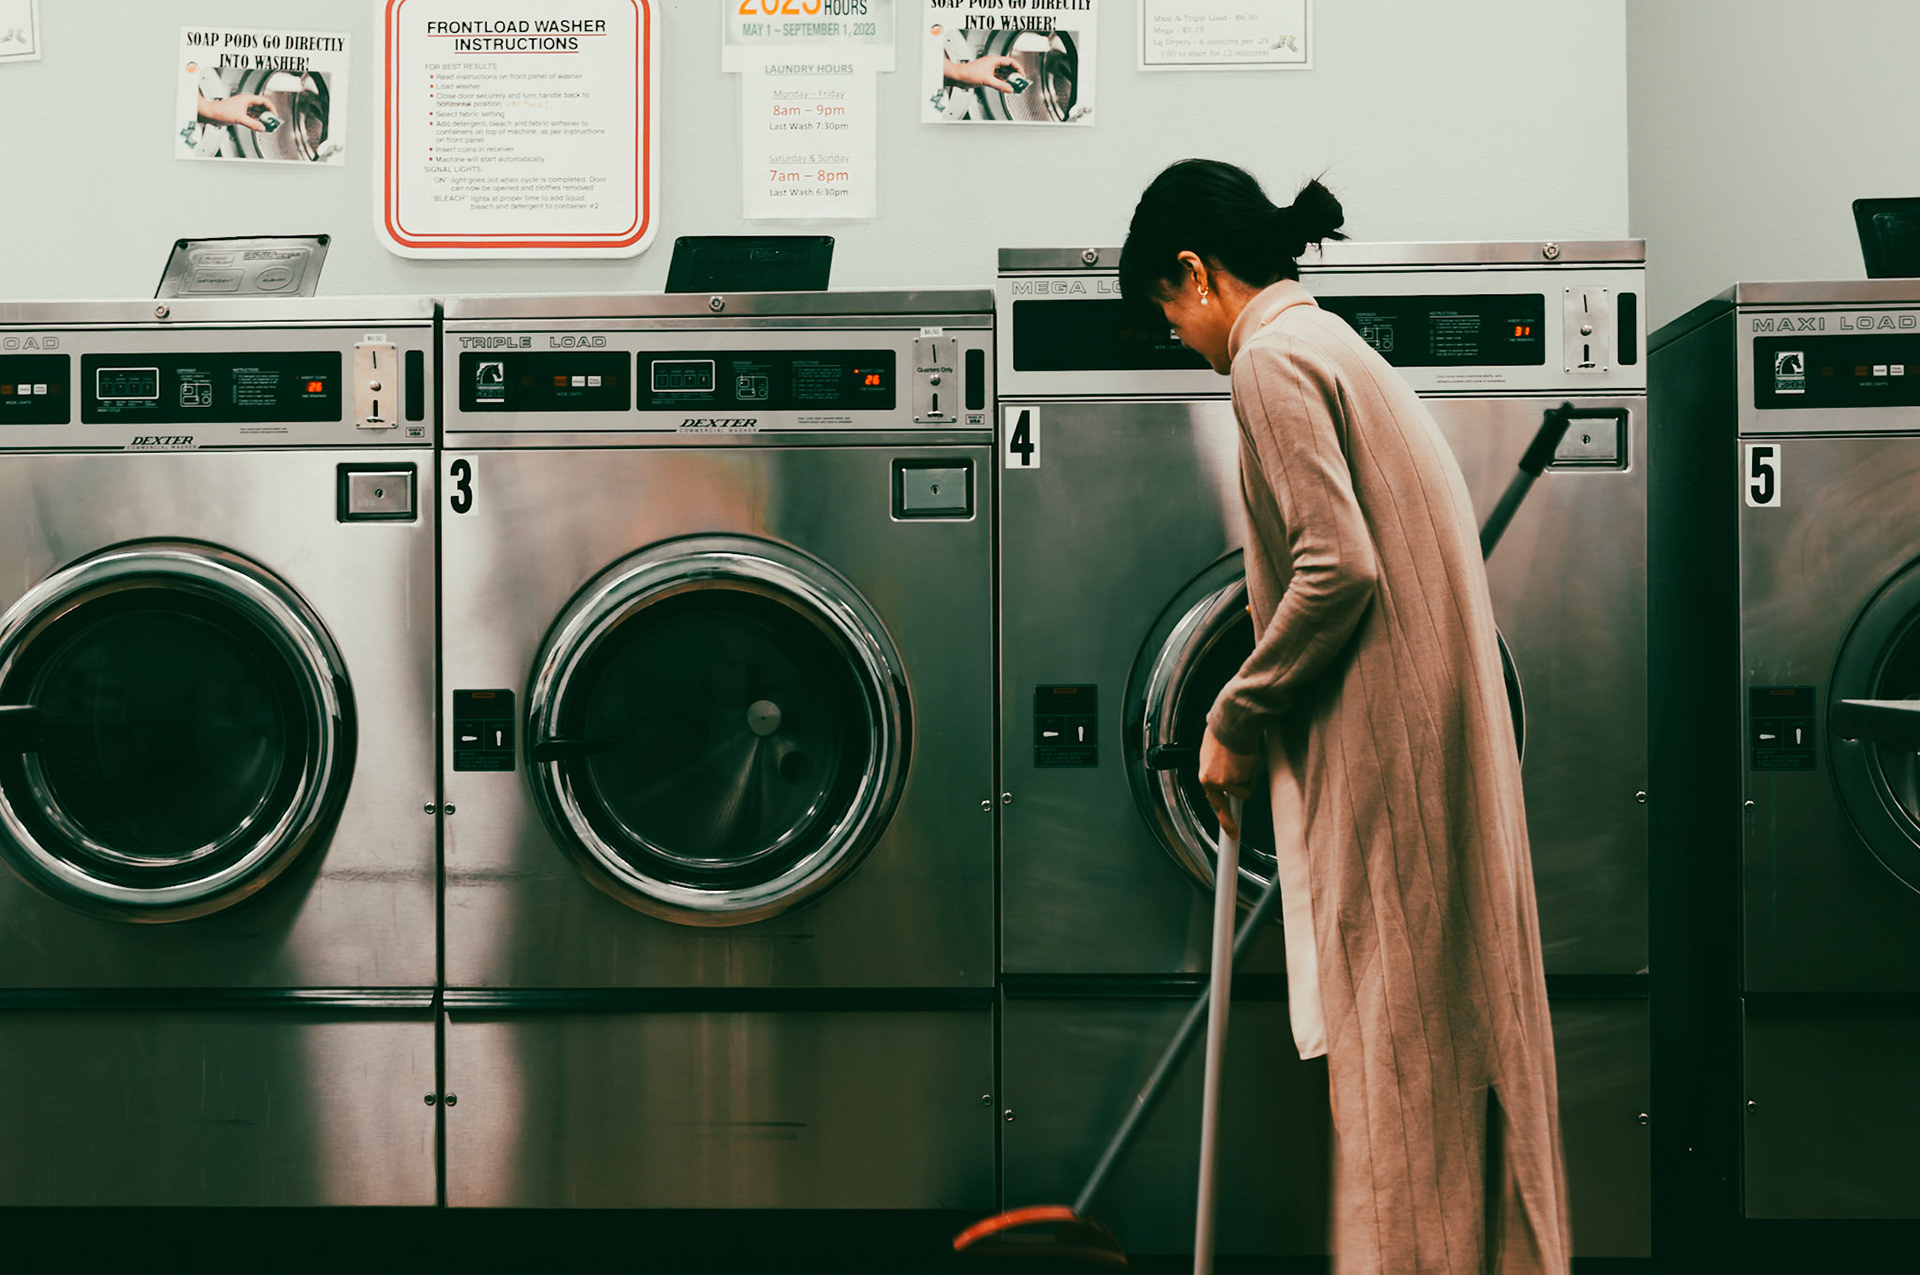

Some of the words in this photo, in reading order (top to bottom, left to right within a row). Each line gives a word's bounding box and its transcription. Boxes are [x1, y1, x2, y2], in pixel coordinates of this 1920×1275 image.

[824, 0, 868, 15] HOURS
[969, 0, 1003, 8] PODS
[427, 21, 530, 34] FRONTLOAD
[535, 19, 606, 33] WASHER
[742, 23, 763, 36] MAY
[766, 23, 771, 36] 1
[782, 23, 840, 36] SEPTEMBER
[853, 22, 876, 36] 2023
[965, 15, 995, 30] INTO
[1000, 15, 1057, 31] WASHER!
[187, 32, 219, 47] SOAP
[224, 33, 258, 49] PODS
[263, 35, 281, 50] GO
[285, 35, 345, 52] DIRECTLY
[455, 37, 579, 51] INSTRUCTIONS
[219, 53, 249, 68] INTO
[254, 54, 310, 71] WASHER!
[463, 62, 498, 70] RESULTS
[764, 64, 814, 74] LAUNDRY
[817, 64, 854, 74] HOURS
[773, 90, 808, 99] Monday
[818, 90, 845, 99] Friday
[772, 104, 801, 116] 8am
[816, 104, 845, 118] 9pm
[769, 122, 787, 131] Last
[789, 122, 813, 131] Wash
[815, 122, 849, 131] 7:30pm
[768, 154, 806, 163] Saturday
[818, 154, 849, 163] Sunday
[768, 169, 800, 182] 7am
[817, 169, 849, 184] 8pm
[769, 188, 787, 197] Last
[789, 188, 813, 197] Wash
[815, 188, 849, 197] 6:30pm
[1012, 280, 1087, 295] MEGA
[1097, 280, 1121, 294] LO
[1752, 317, 1825, 333] MAXI
[1840, 315, 1917, 331] LOAD
[1514, 325, 1531, 338] 31
[0, 336, 60, 351] OAD
[459, 336, 532, 349] TRIPLE
[550, 335, 607, 349] LOAD
[306, 381, 323, 393] 26
[864, 374, 880, 386] 26
[679, 418, 758, 428] DEXTER
[130, 436, 194, 446] DEXTER
[1010, 409, 1035, 467] 4
[1751, 447, 1775, 504] 5
[450, 459, 473, 514] 3
